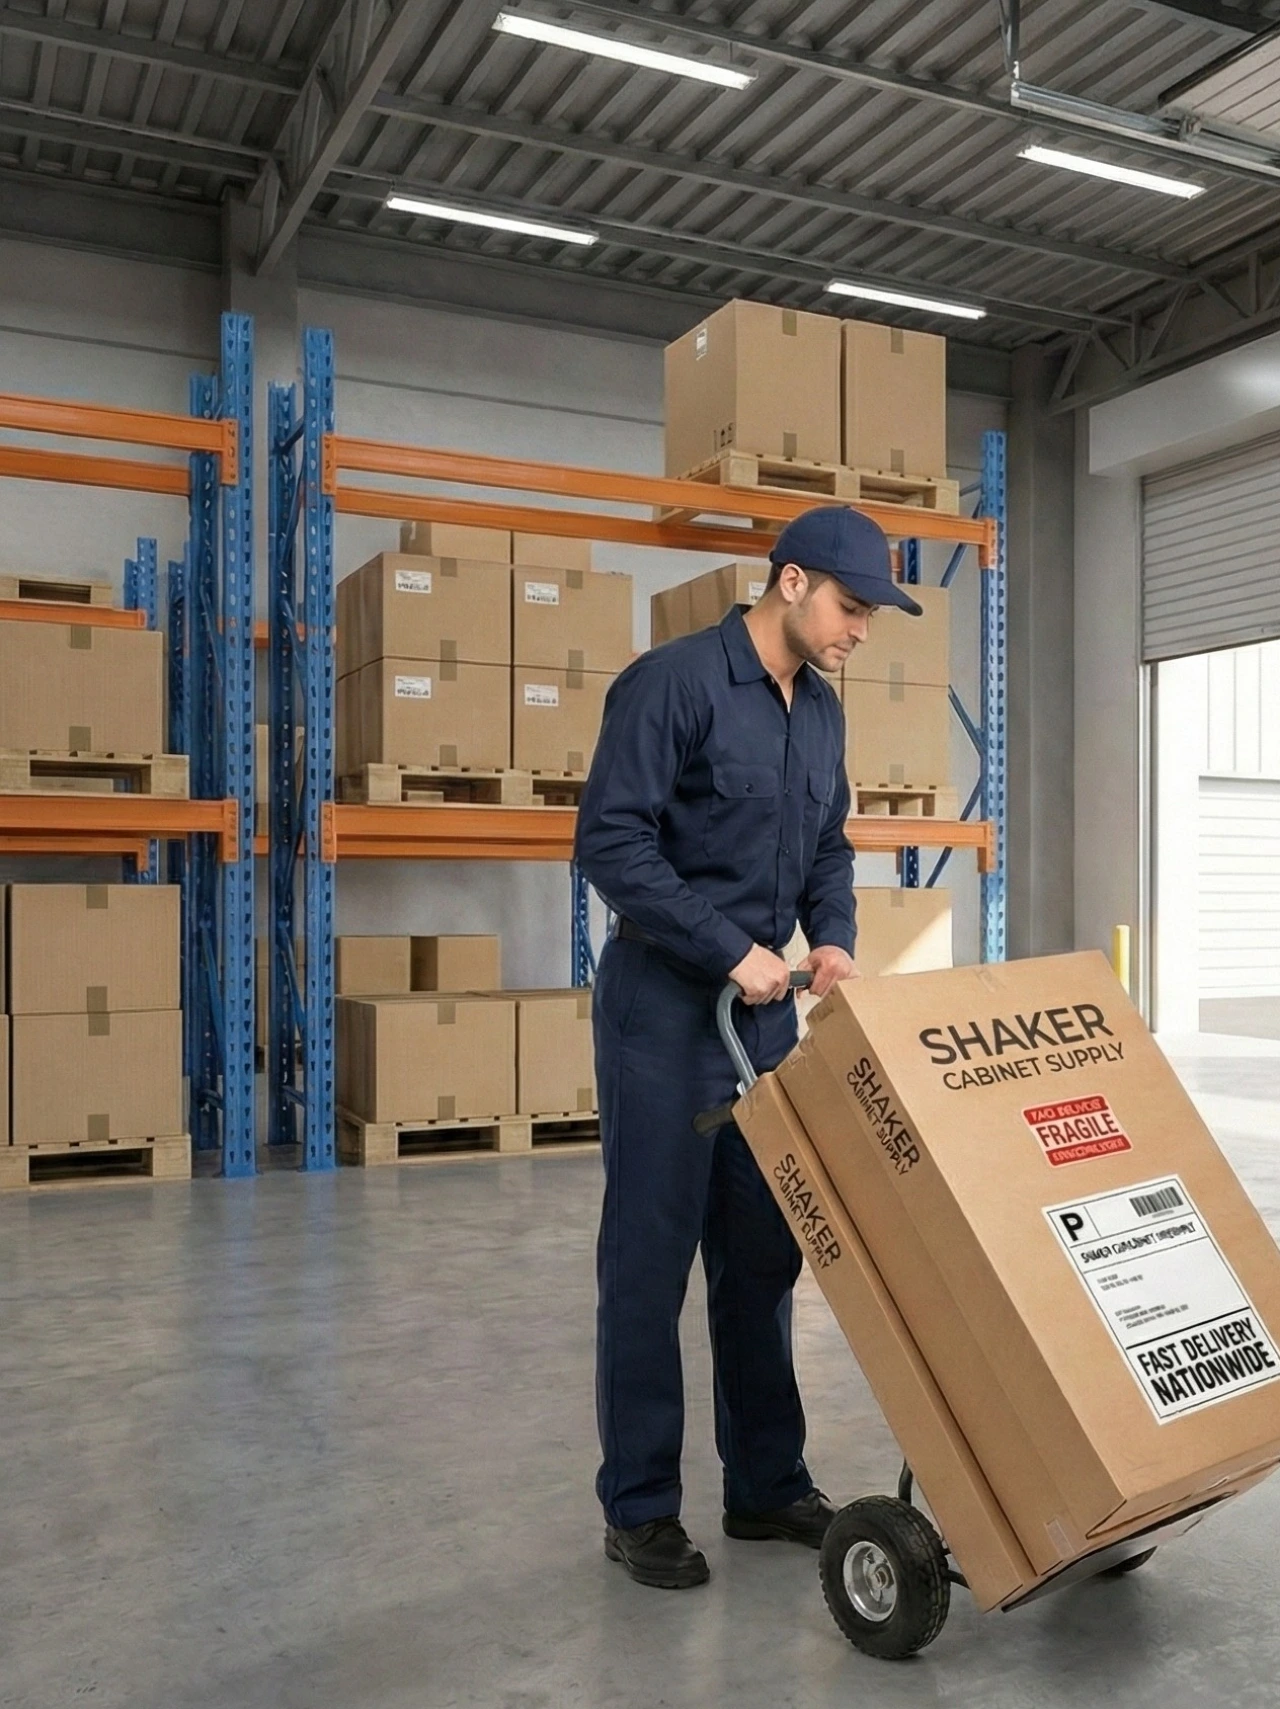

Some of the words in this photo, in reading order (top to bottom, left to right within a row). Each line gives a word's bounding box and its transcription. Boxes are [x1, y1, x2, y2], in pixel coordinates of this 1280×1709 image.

[919, 1004, 1114, 1065] SHAKER
[943, 1057, 1042, 1090] CABINET
[1045, 1042, 1125, 1072] SUPPLY
[854, 1057, 920, 1168] SHAKER
[1036, 1113, 1119, 1147] FRAGILE
[780, 1153, 841, 1264] SHAKER
[1059, 1212, 1084, 1242] P
[1137, 1343, 1182, 1376] FAST
[1180, 1317, 1257, 1361] DELIVERY
[1150, 1341, 1276, 1406] NATIONWIDE
